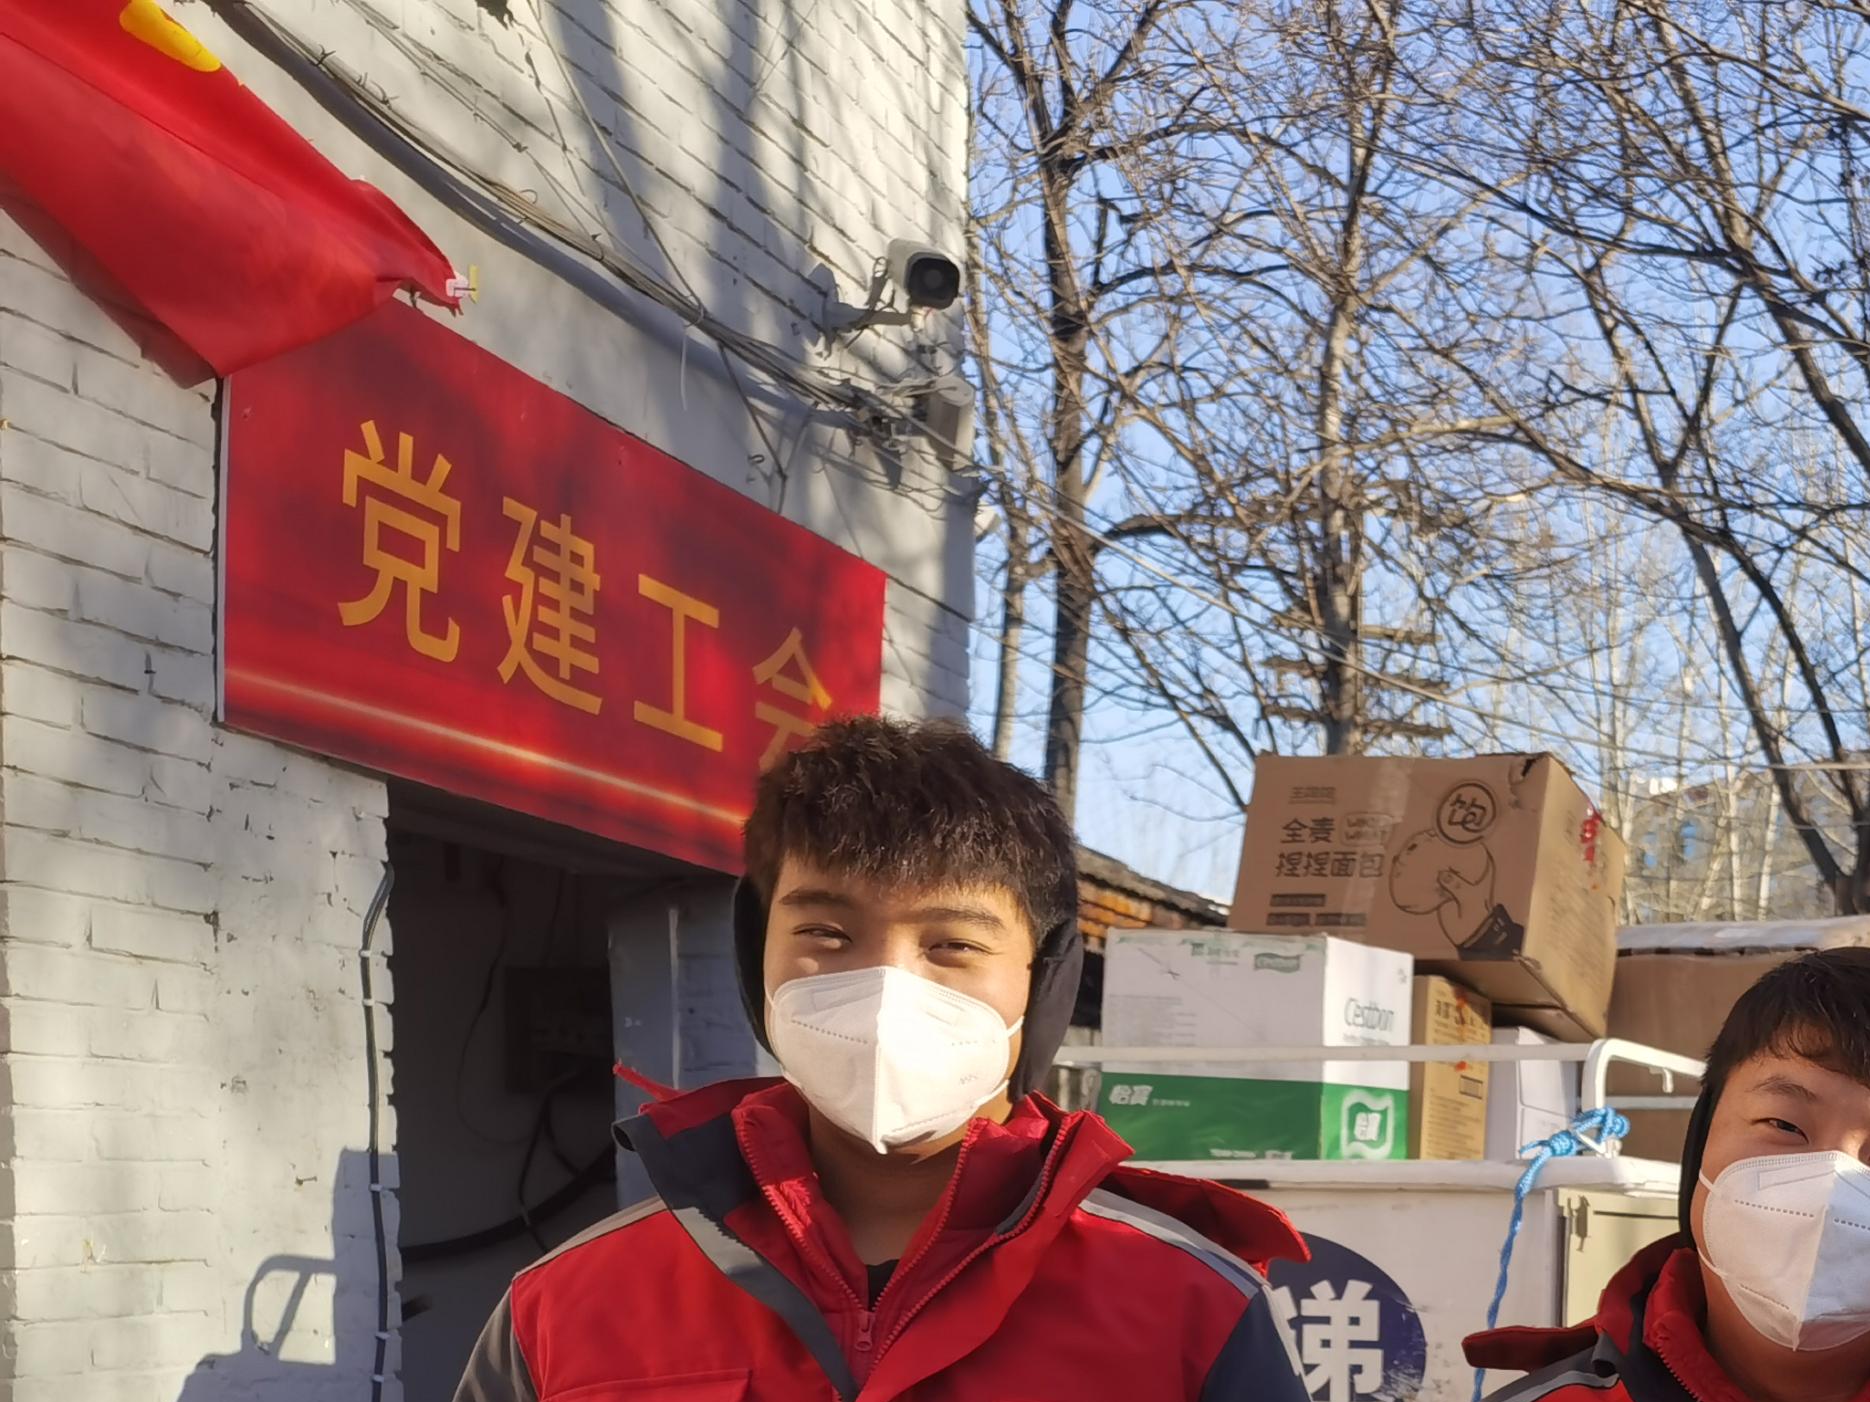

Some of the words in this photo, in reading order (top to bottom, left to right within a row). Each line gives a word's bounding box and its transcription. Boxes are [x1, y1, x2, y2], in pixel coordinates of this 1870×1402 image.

[338, 419, 833, 775] 党建工会
[1276, 852, 1385, 878] 捏捏面包
